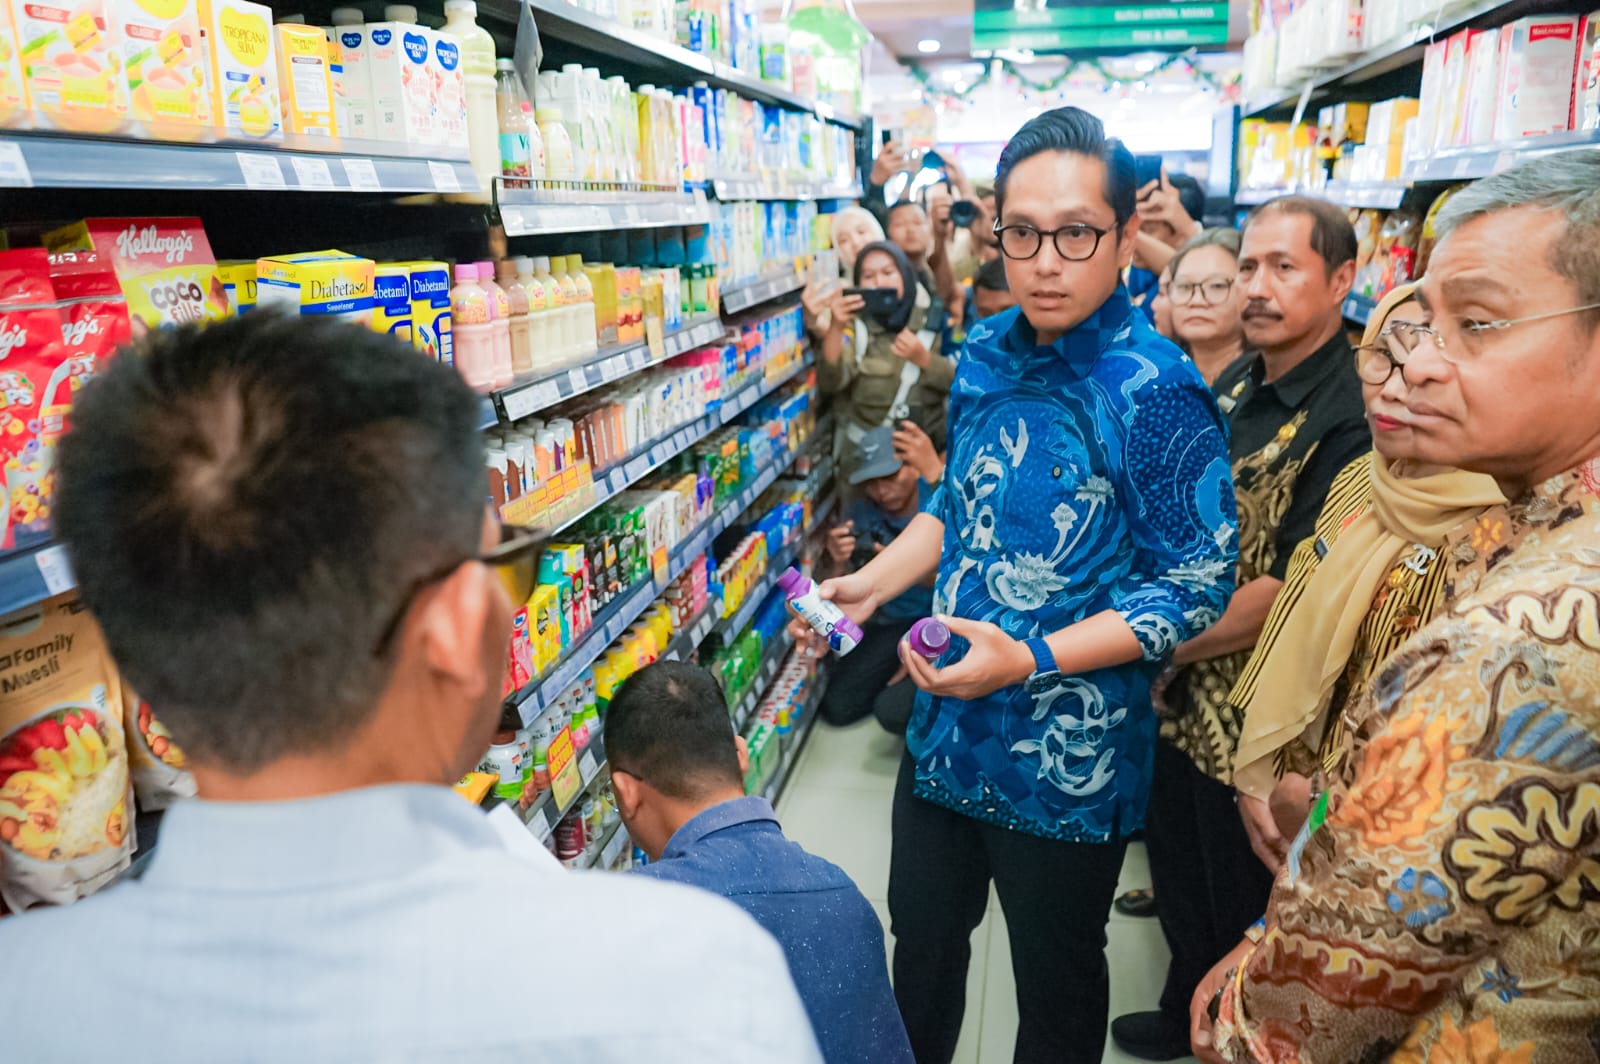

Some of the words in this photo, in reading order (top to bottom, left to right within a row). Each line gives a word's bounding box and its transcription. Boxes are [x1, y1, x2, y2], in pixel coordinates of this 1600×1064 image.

[224, 25, 267, 44] TROPICANA
[238, 40, 256, 55] SLIM
[116, 223, 193, 263] Kellogg's
[311, 275, 368, 299] Diabetasol
[374, 282, 408, 299] abetamil
[413, 276, 448, 294] Diabetamil
[13, 632, 75, 667] Family
[2, 655, 60, 693] Muesli
